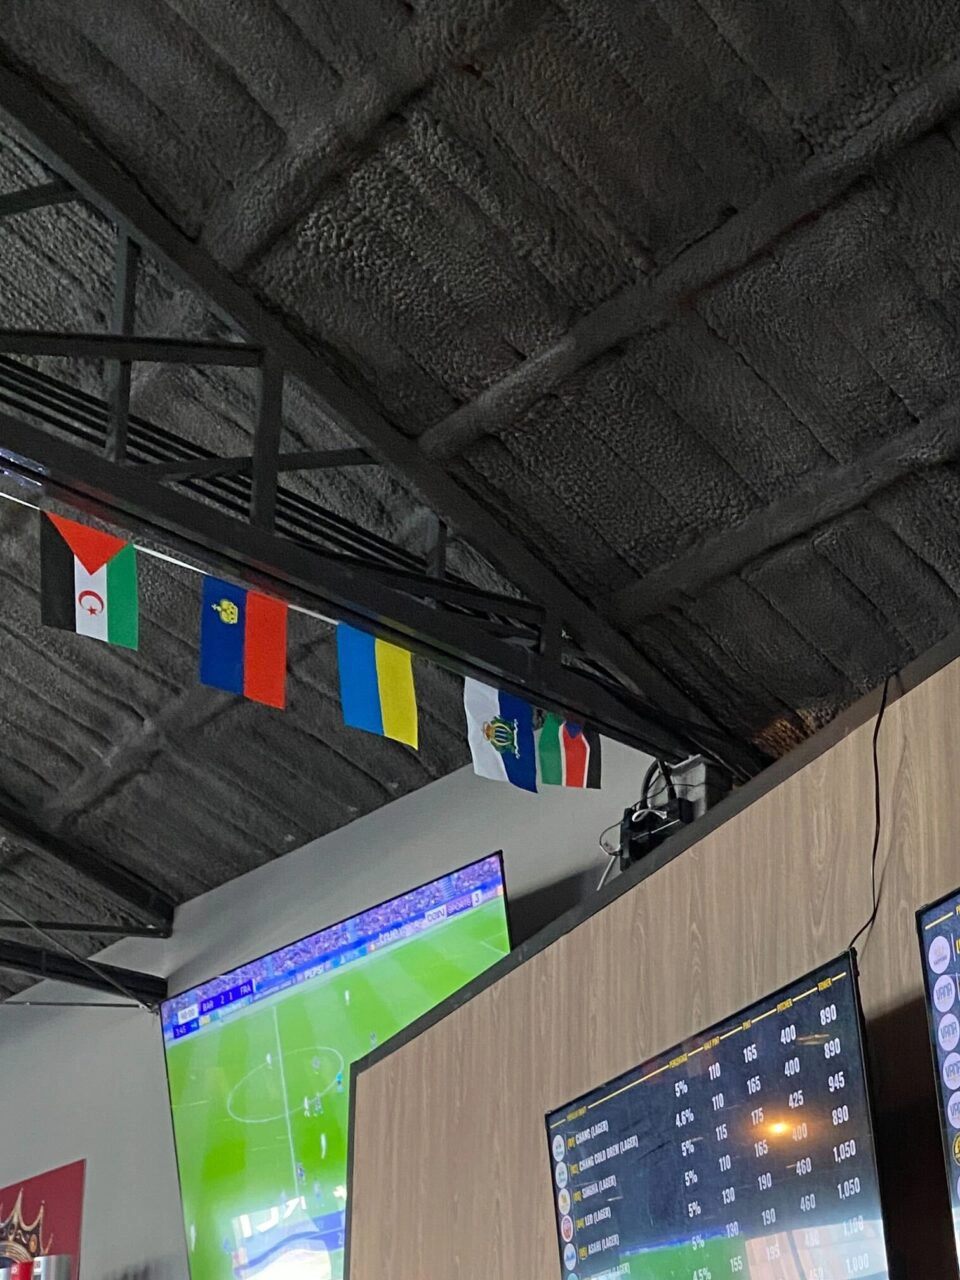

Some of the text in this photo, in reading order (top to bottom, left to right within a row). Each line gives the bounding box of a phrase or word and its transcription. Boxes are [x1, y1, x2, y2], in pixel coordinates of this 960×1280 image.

[202, 1000, 214, 1011] BAR
[819, 1004, 837, 1026] 890
[780, 1025, 796, 1045] 400
[743, 1044, 758, 1064] 165
[824, 1038, 841, 1059] 890
[708, 1062, 721, 1081] 110
[784, 1057, 800, 1077] 400
[674, 1080, 688, 1098] 5%
[746, 1076, 761, 1095] 165
[828, 1071, 845, 1092] 945
[712, 1093, 725, 1111] 110
[788, 1090, 804, 1109] 425
[675, 1107, 695, 1128] 4.6%
[751, 1107, 764, 1126] 175
[832, 1104, 849, 1126] 890
[575, 1120, 609, 1145] CHANG (LAGER)
[716, 1124, 728, 1142] 115
[792, 1123, 808, 1142] 400
[579, 1155, 594, 1171] CHANG
[594, 1149, 606, 1164] COLD
[620, 1135, 639, 1155] (LAGER)
[681, 1139, 695, 1157] 5%
[754, 1139, 769, 1158] 165
[833, 1139, 857, 1163] 1,050
[719, 1154, 731, 1172] 110
[796, 1157, 812, 1176] 460
[684, 1169, 698, 1187] 5%
[758, 1172, 773, 1191] 190
[722, 1187, 736, 1205] 130
[837, 1177, 861, 1200] 1,050
[688, 1200, 701, 1218] 5%
[800, 1193, 816, 1212] 460
[761, 1207, 776, 1226] 190
[726, 1221, 739, 1239] 130
[691, 1233, 705, 1251] 5%
[730, 1256, 743, 1273] 155
